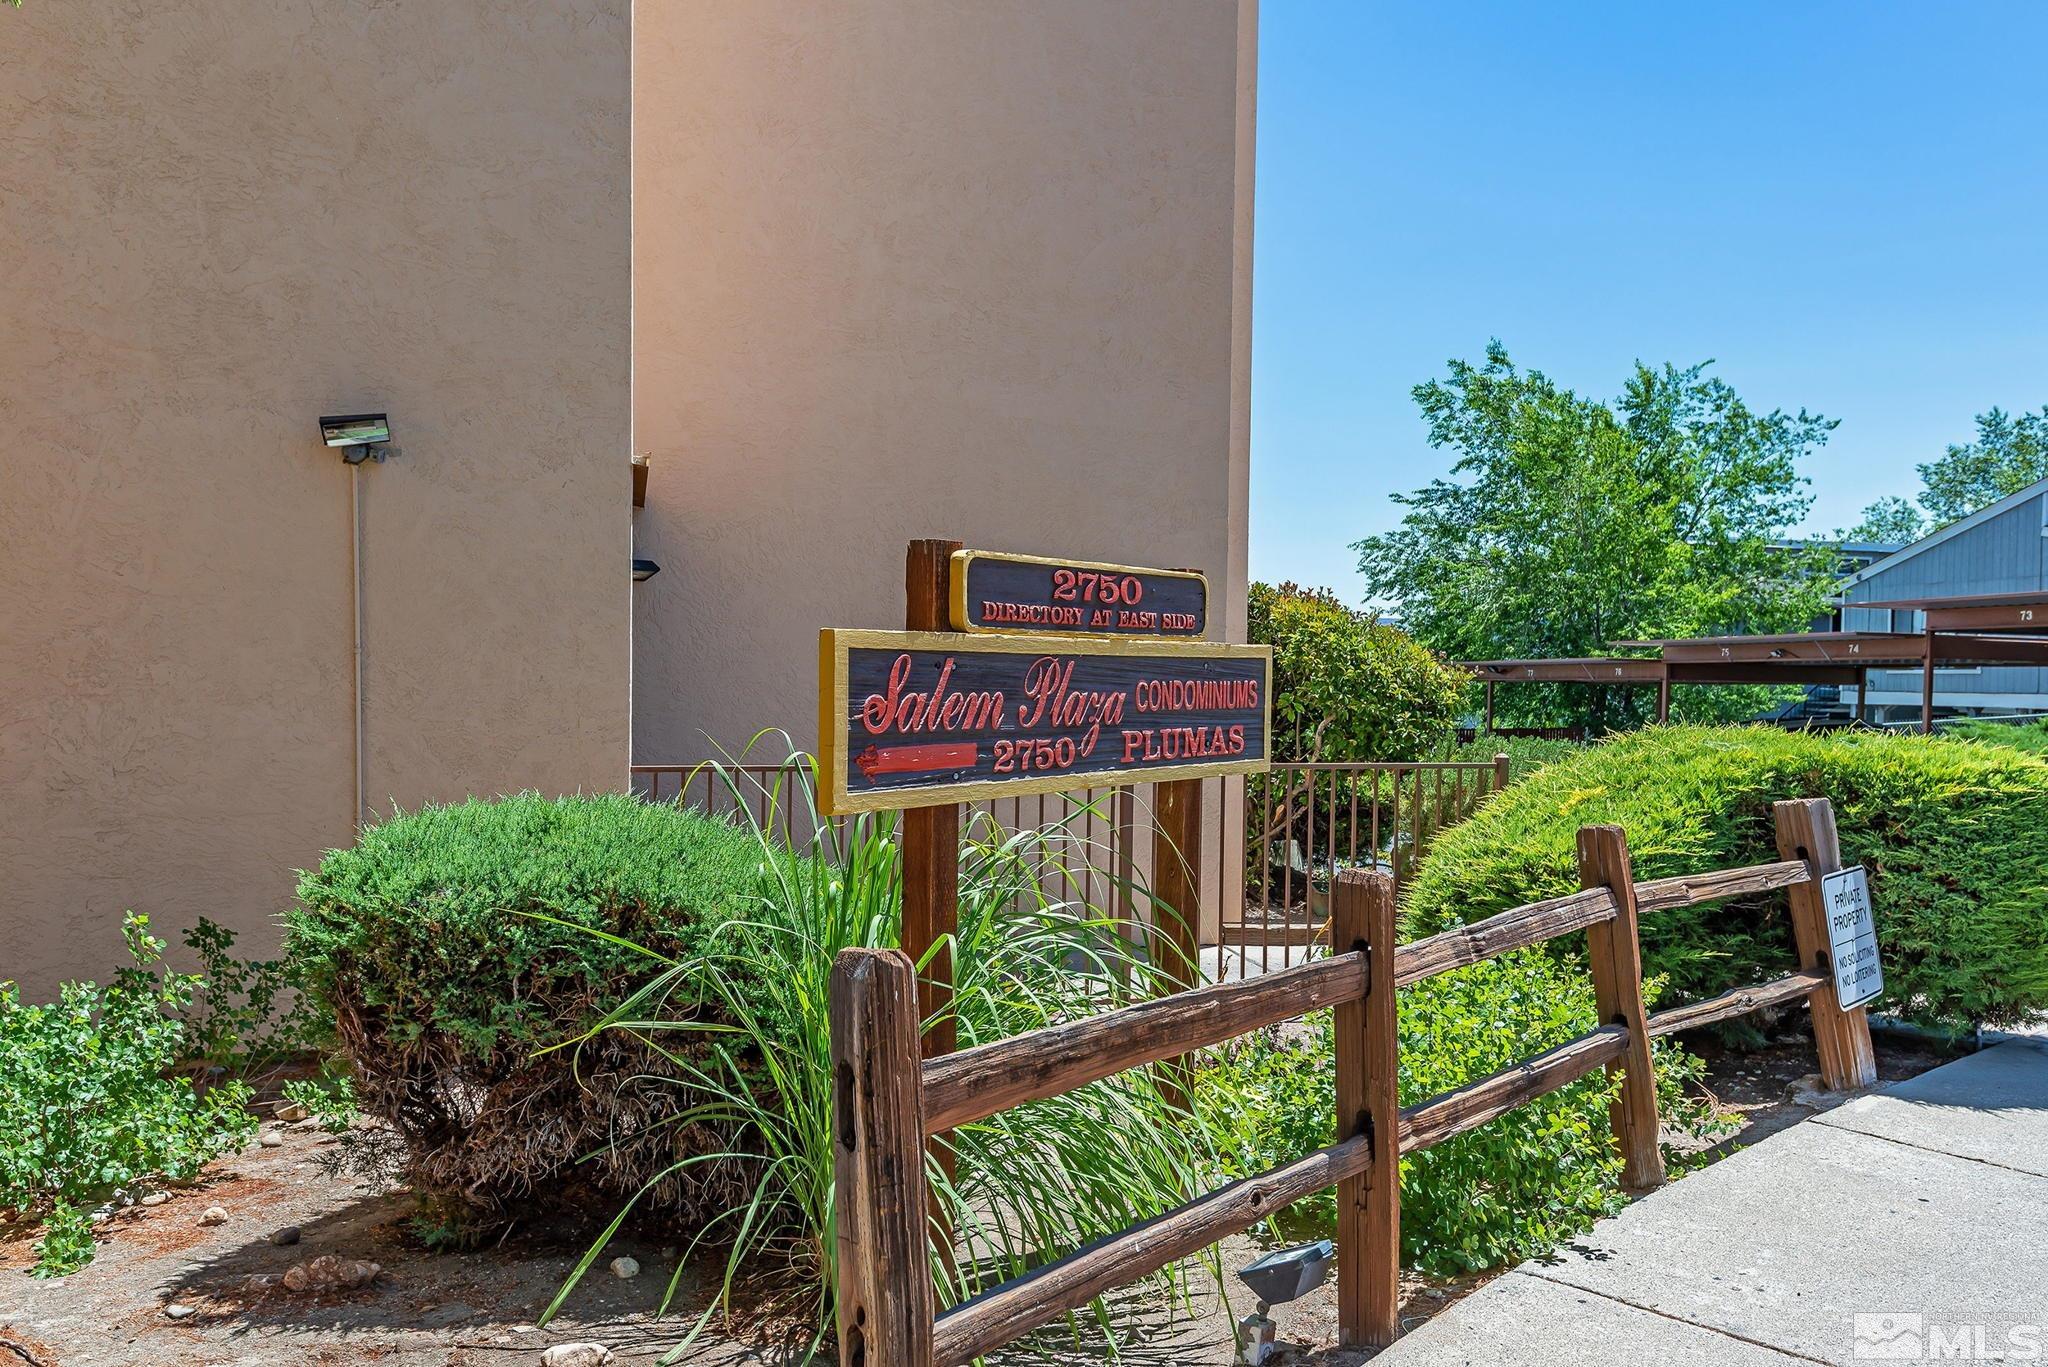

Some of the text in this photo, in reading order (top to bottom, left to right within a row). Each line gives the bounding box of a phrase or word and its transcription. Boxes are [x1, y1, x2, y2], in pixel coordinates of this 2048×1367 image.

[1054, 569, 1143, 605] 2750
[982, 601, 1196, 630] DIRECTORY AT EAST SIDE
[2020, 610, 2033, 621] 73
[1721, 648, 1730, 656] 75
[1848, 644, 1859, 653] 74
[863, 653, 1258, 758] Salem Plaza CONDOMINIUMS
[992, 725, 1245, 774] 2750 PLUMAS
[1834, 887, 1862, 910] PRIVATE
[1833, 905, 1868, 932] PROPERTY
[1839, 945, 1875, 969] NO SOLICITING
[1842, 963, 1876, 988] NO LOITERING
